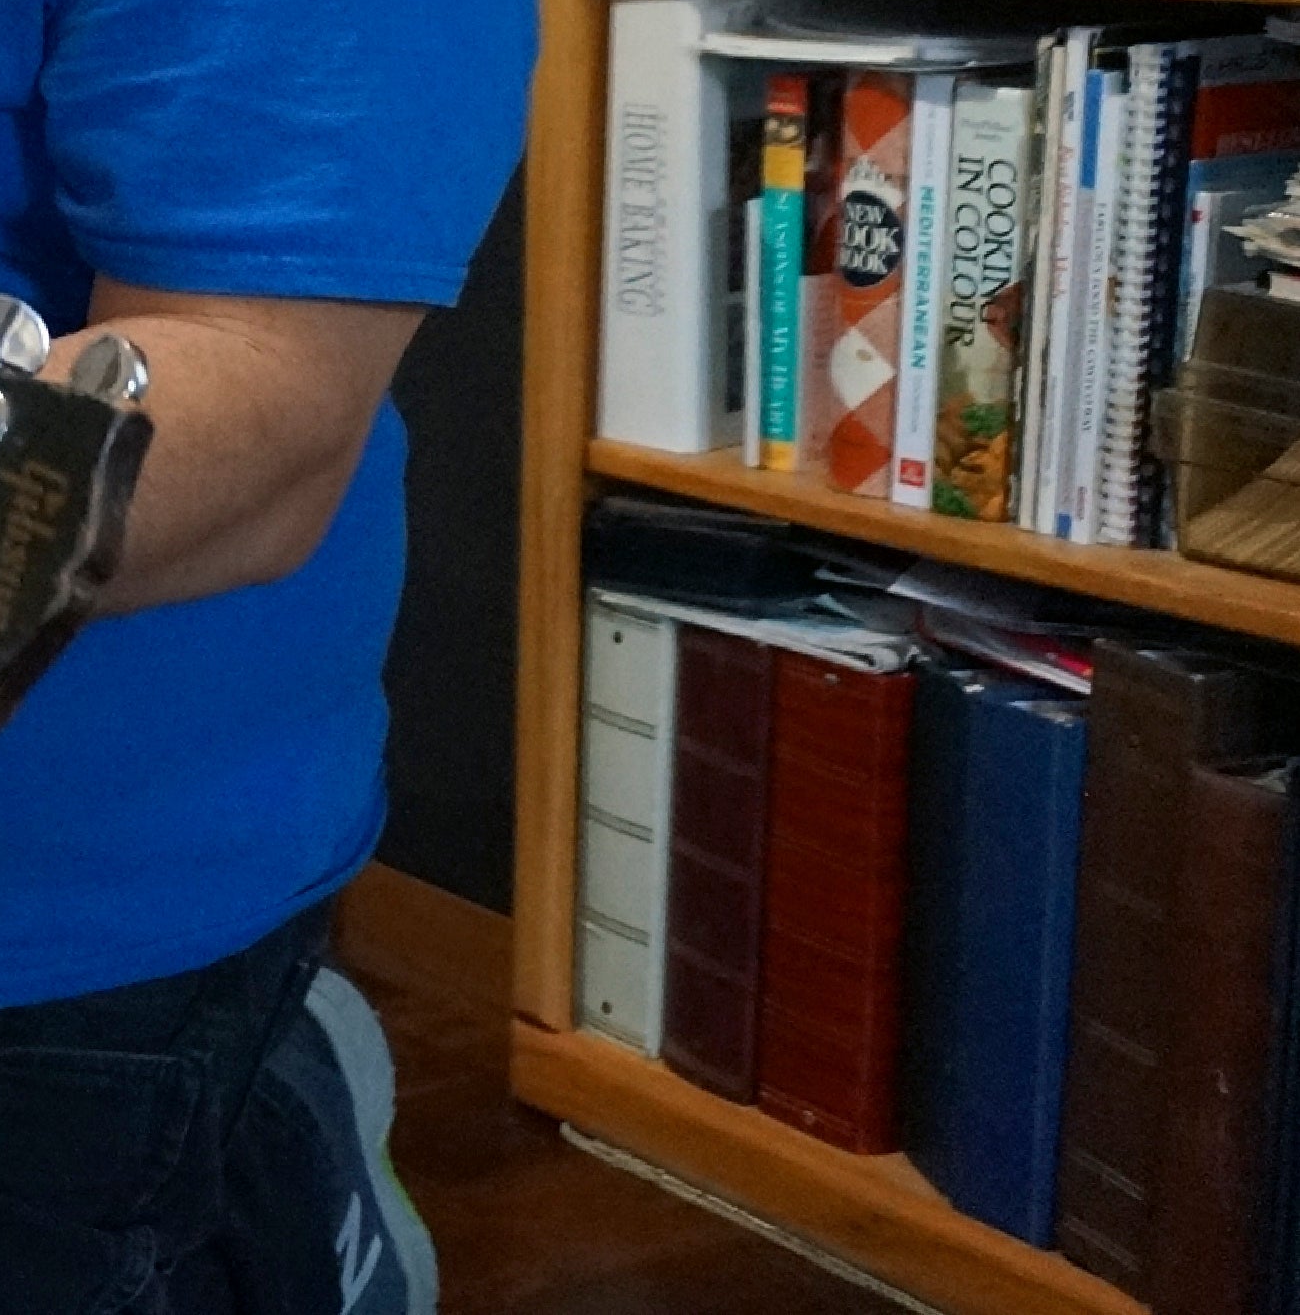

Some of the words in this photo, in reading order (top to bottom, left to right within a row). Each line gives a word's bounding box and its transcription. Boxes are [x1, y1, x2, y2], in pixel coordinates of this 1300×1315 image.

[957, 154, 984, 191] IN
[980, 159, 1018, 326] COOKING
[910, 185, 936, 370] MEDITERRANEAN
[946, 202, 981, 348] COLOUR
